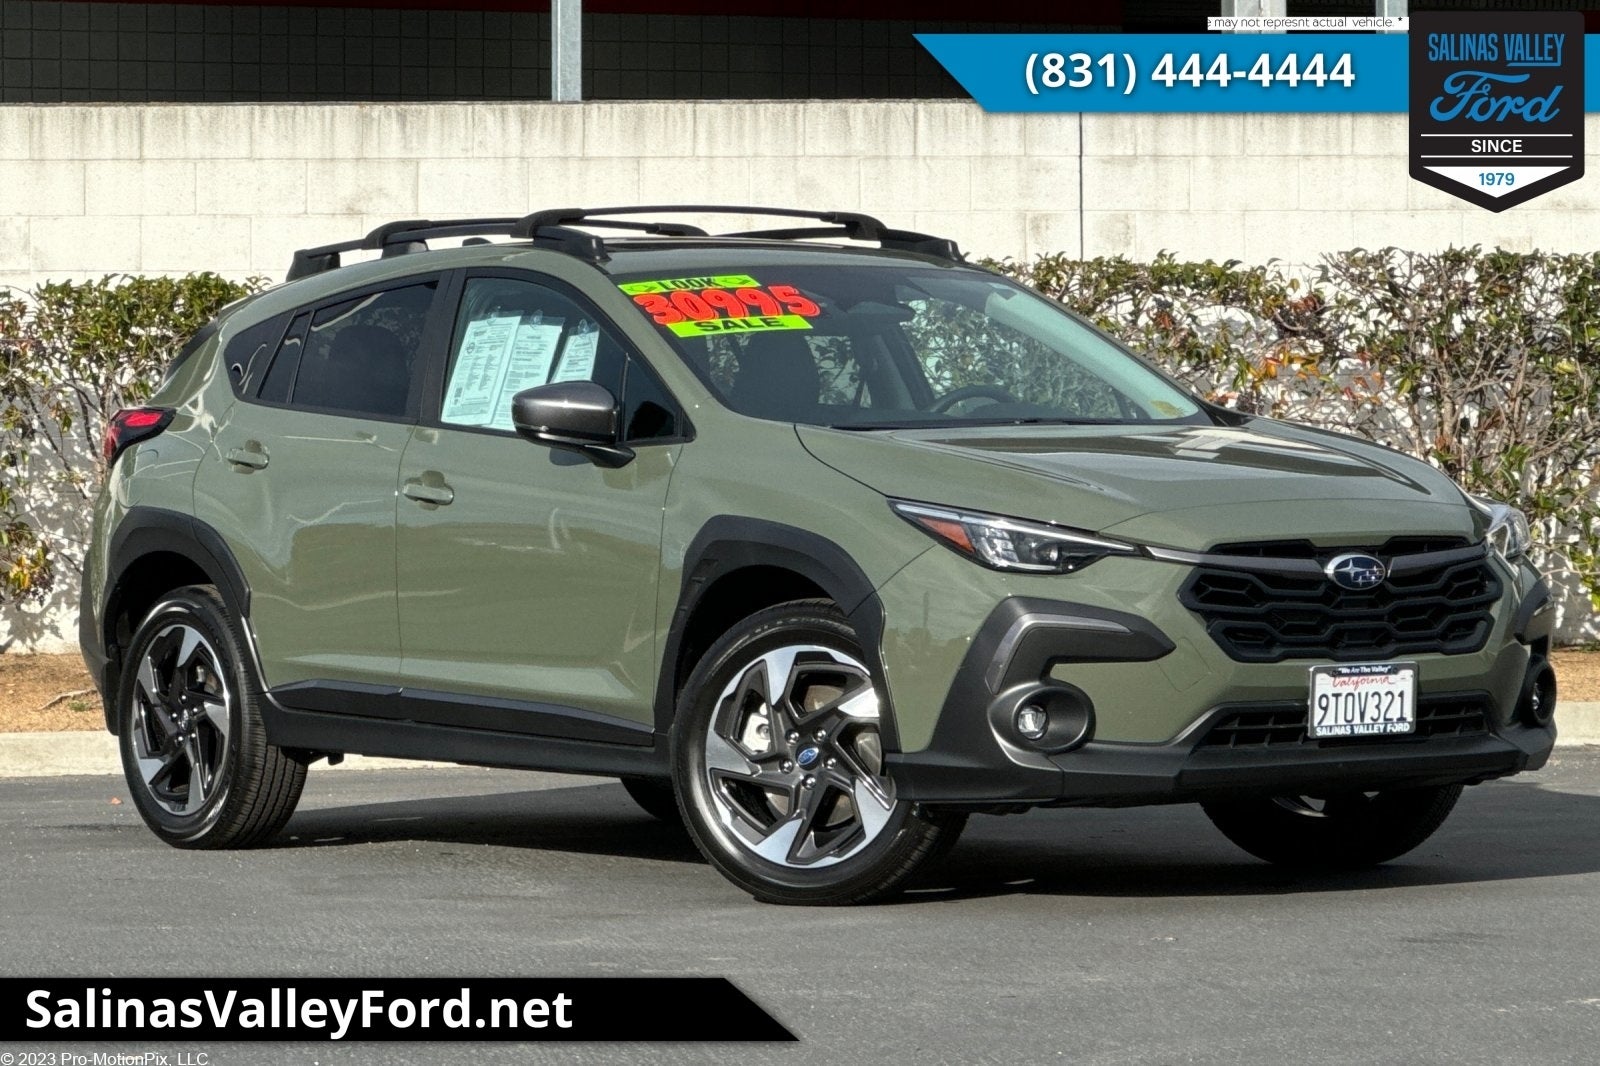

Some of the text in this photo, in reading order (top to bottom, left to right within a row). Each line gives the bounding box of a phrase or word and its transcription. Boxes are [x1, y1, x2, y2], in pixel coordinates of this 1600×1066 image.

[657, 277, 720, 291] LOOK
[633, 283, 820, 326] 30995
[694, 316, 785, 332] SALE
[1360, 665, 1371, 673] The
[1332, 674, 1396, 691] California
[1316, 722, 1410, 737] SALINAS VALLEY FORD
